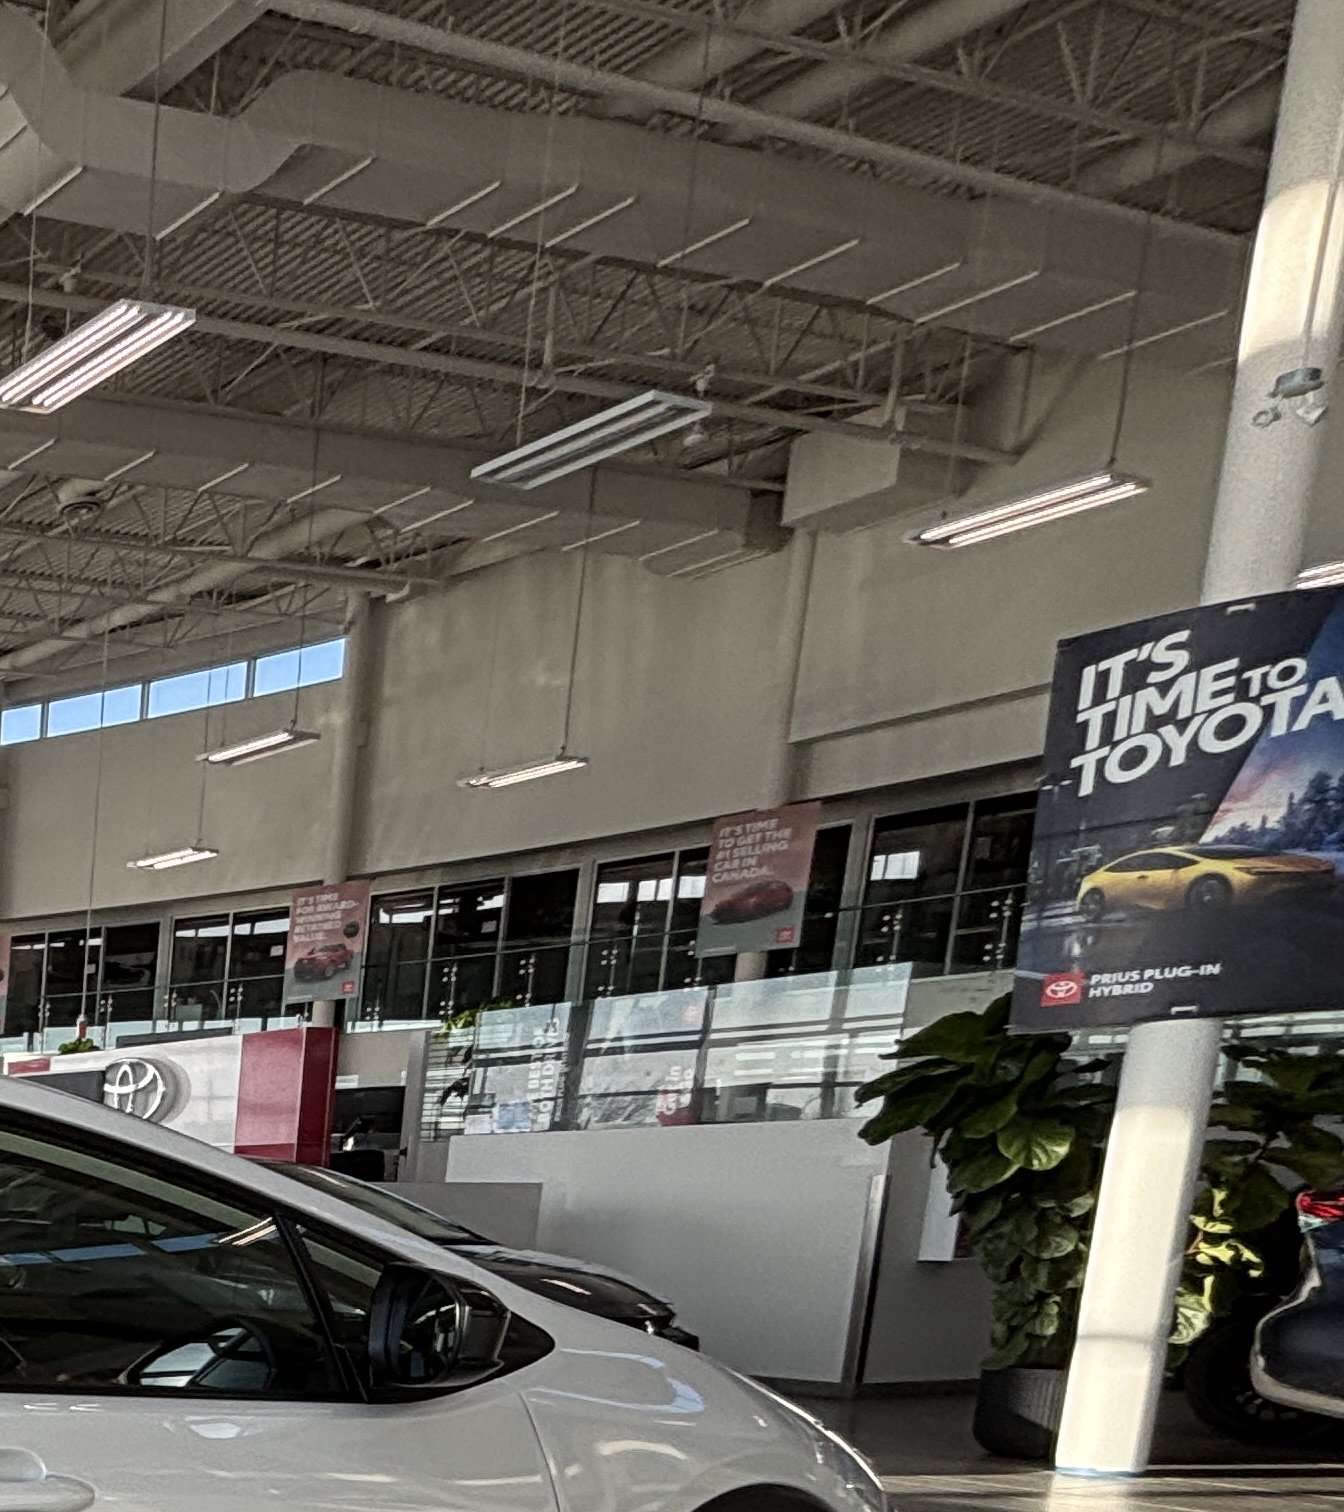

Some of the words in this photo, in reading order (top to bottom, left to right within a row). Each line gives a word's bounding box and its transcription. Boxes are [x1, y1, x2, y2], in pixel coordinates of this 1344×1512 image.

[1077, 629, 1191, 711] IT'S
[1076, 657, 1240, 751] TIME
[1242, 657, 1307, 697] TO
[1070, 676, 1344, 797] TOYOTA
[719, 824, 744, 838] IT'S
[745, 819, 779, 832] TIME
[719, 839, 734, 849] TO
[736, 833, 762, 846] GET
[765, 828, 792, 841] THE
[732, 841, 789, 858] SELLING
[714, 858, 739, 871] CAR
[742, 856, 759, 867] IN
[1089, 970, 1141, 985] PRIUS
[1143, 963, 1222, 980] PLUG-IN
[1088, 982, 1154, 998] HYBRID
